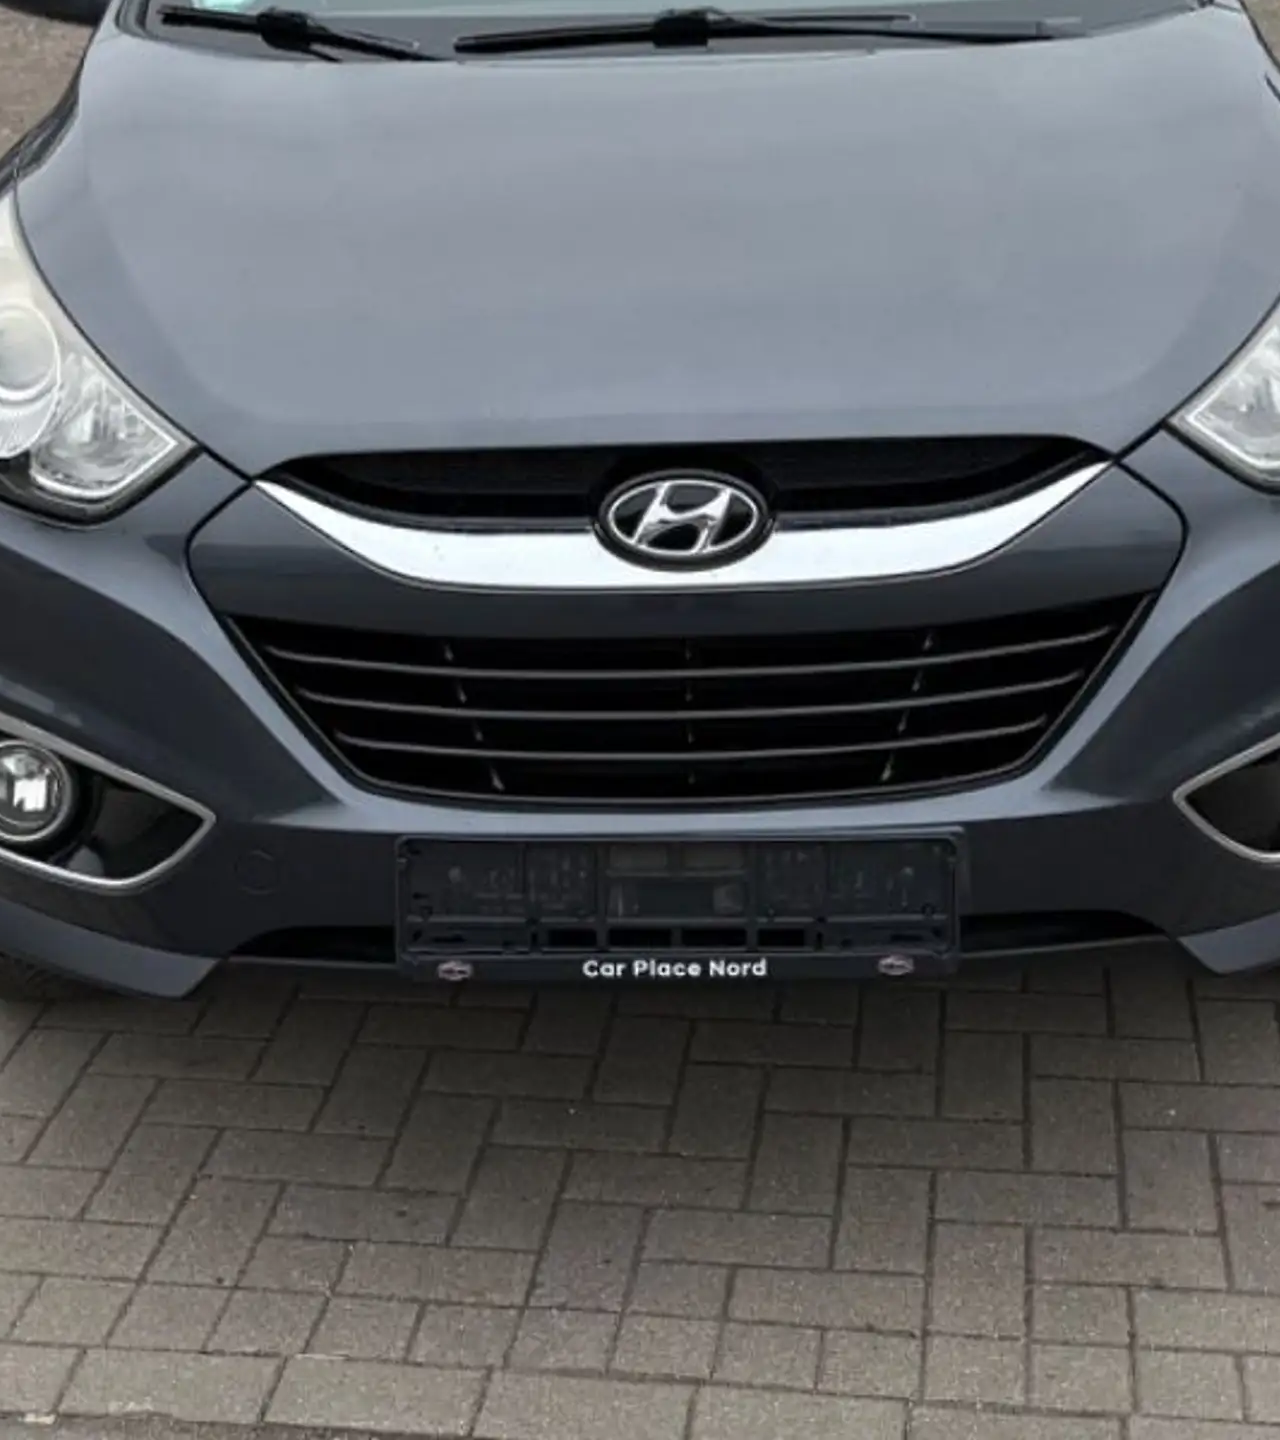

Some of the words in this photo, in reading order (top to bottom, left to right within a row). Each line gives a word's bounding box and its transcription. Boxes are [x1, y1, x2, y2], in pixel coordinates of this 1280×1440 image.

[581, 959, 626, 978] Car
[632, 958, 702, 978] Place
[708, 957, 768, 978] Nord
